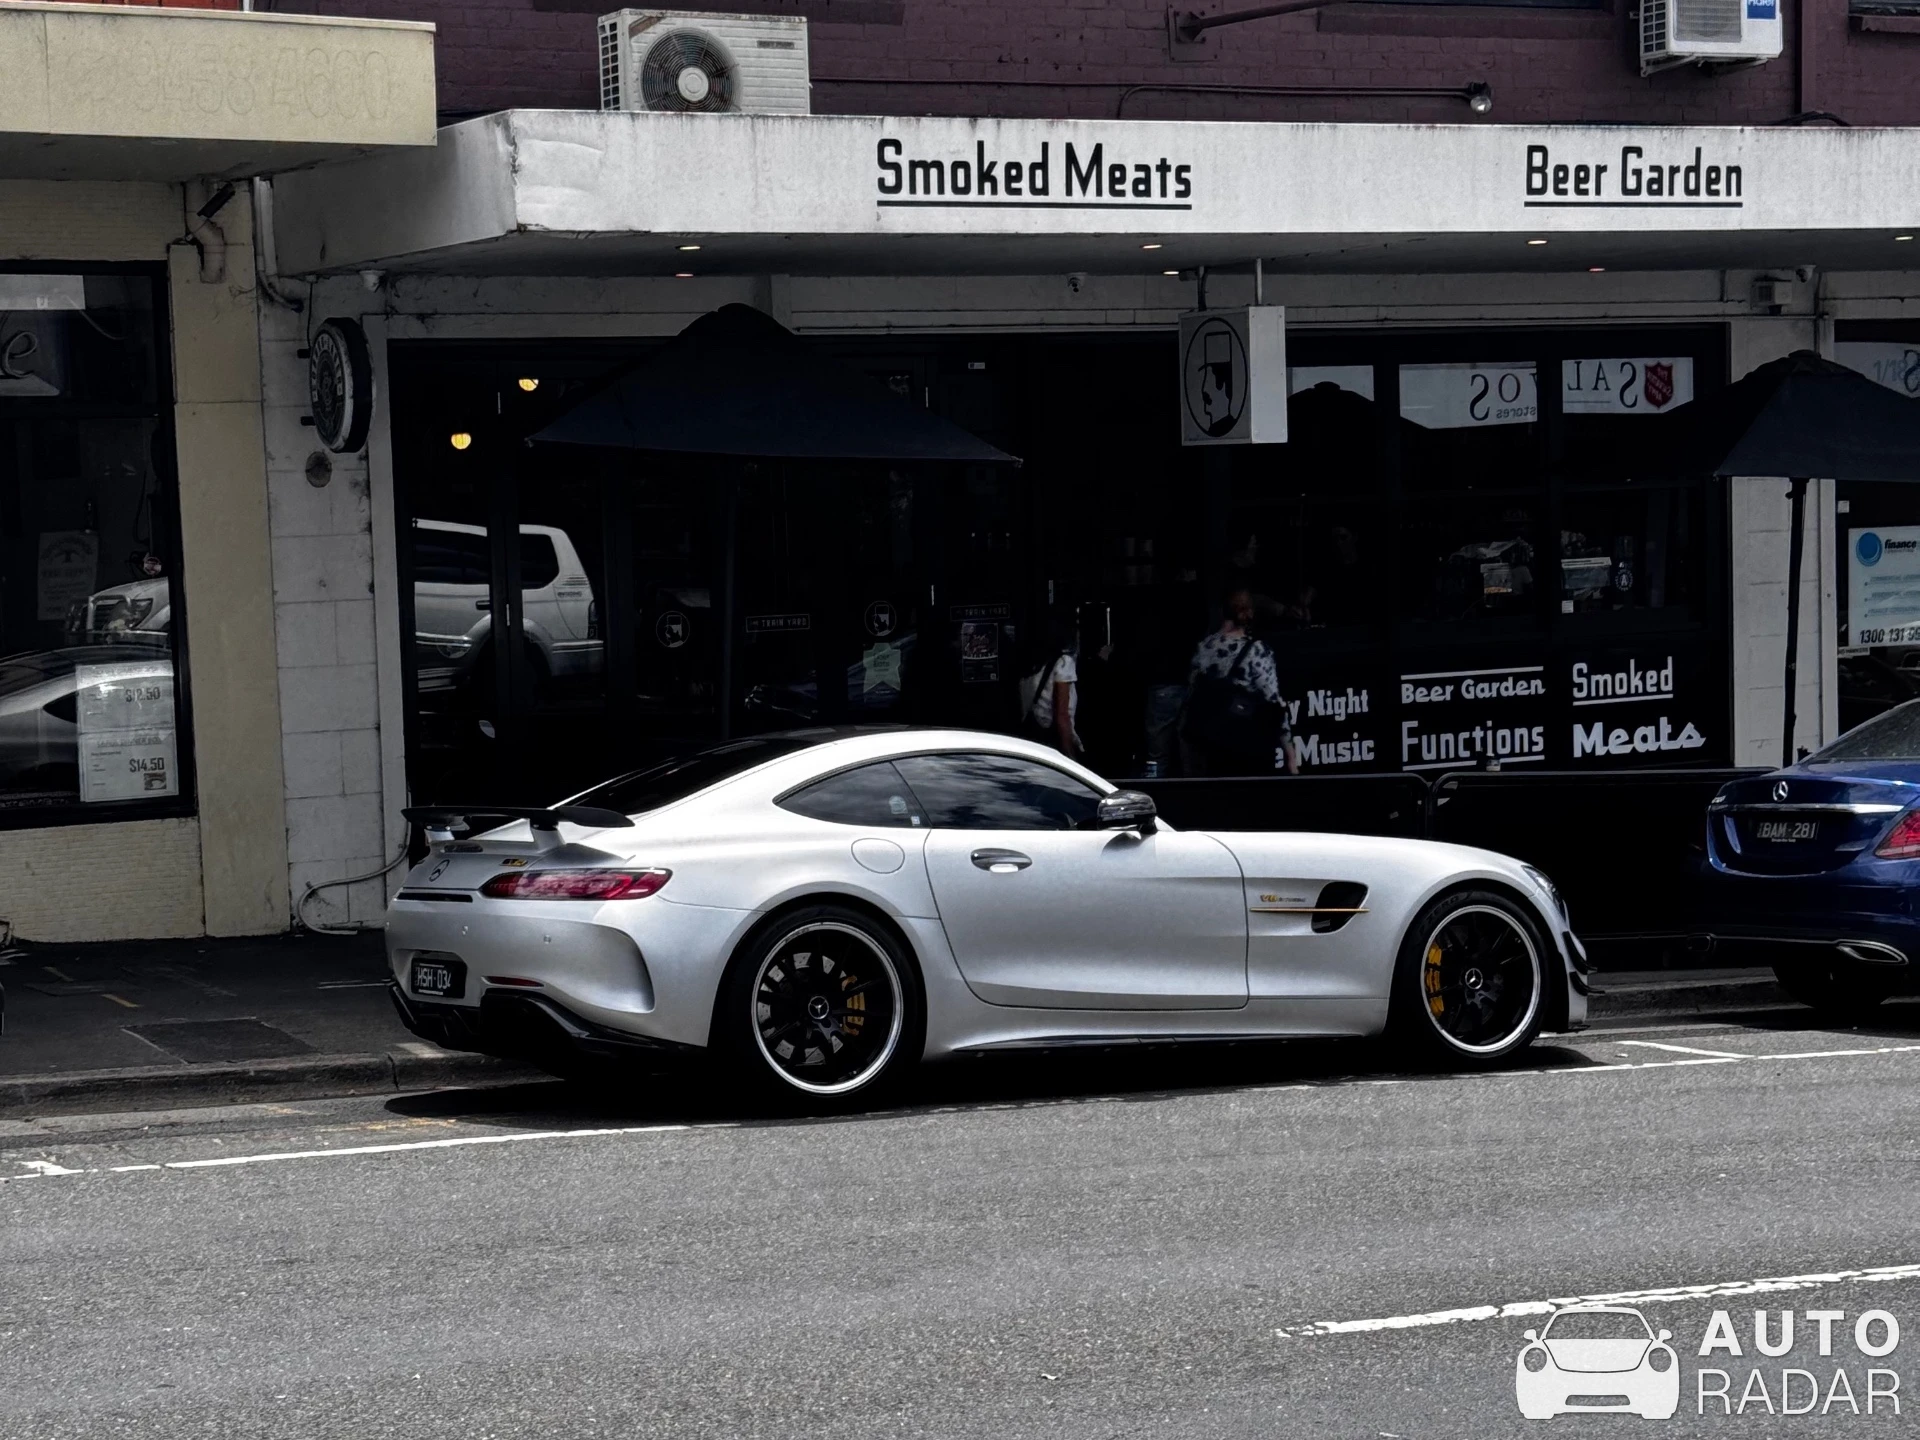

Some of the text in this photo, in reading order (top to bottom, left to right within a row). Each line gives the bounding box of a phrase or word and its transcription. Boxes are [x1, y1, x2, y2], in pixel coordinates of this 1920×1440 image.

[877, 138, 1192, 198] Smoked Meats
[1526, 145, 1742, 197] Beer Garden
[1885, 539, 1917, 550] finance
[1860, 629, 1885, 644] 1300
[1889, 627, 1905, 642] 131
[1401, 676, 1546, 704] Beer Garden
[1572, 656, 1673, 698] Smoked
[1307, 687, 1369, 721] Night
[1293, 731, 1375, 766] Music
[1402, 720, 1544, 763] Functions
[1572, 716, 1707, 758] Meats
[129, 757, 165, 773] $14.50
